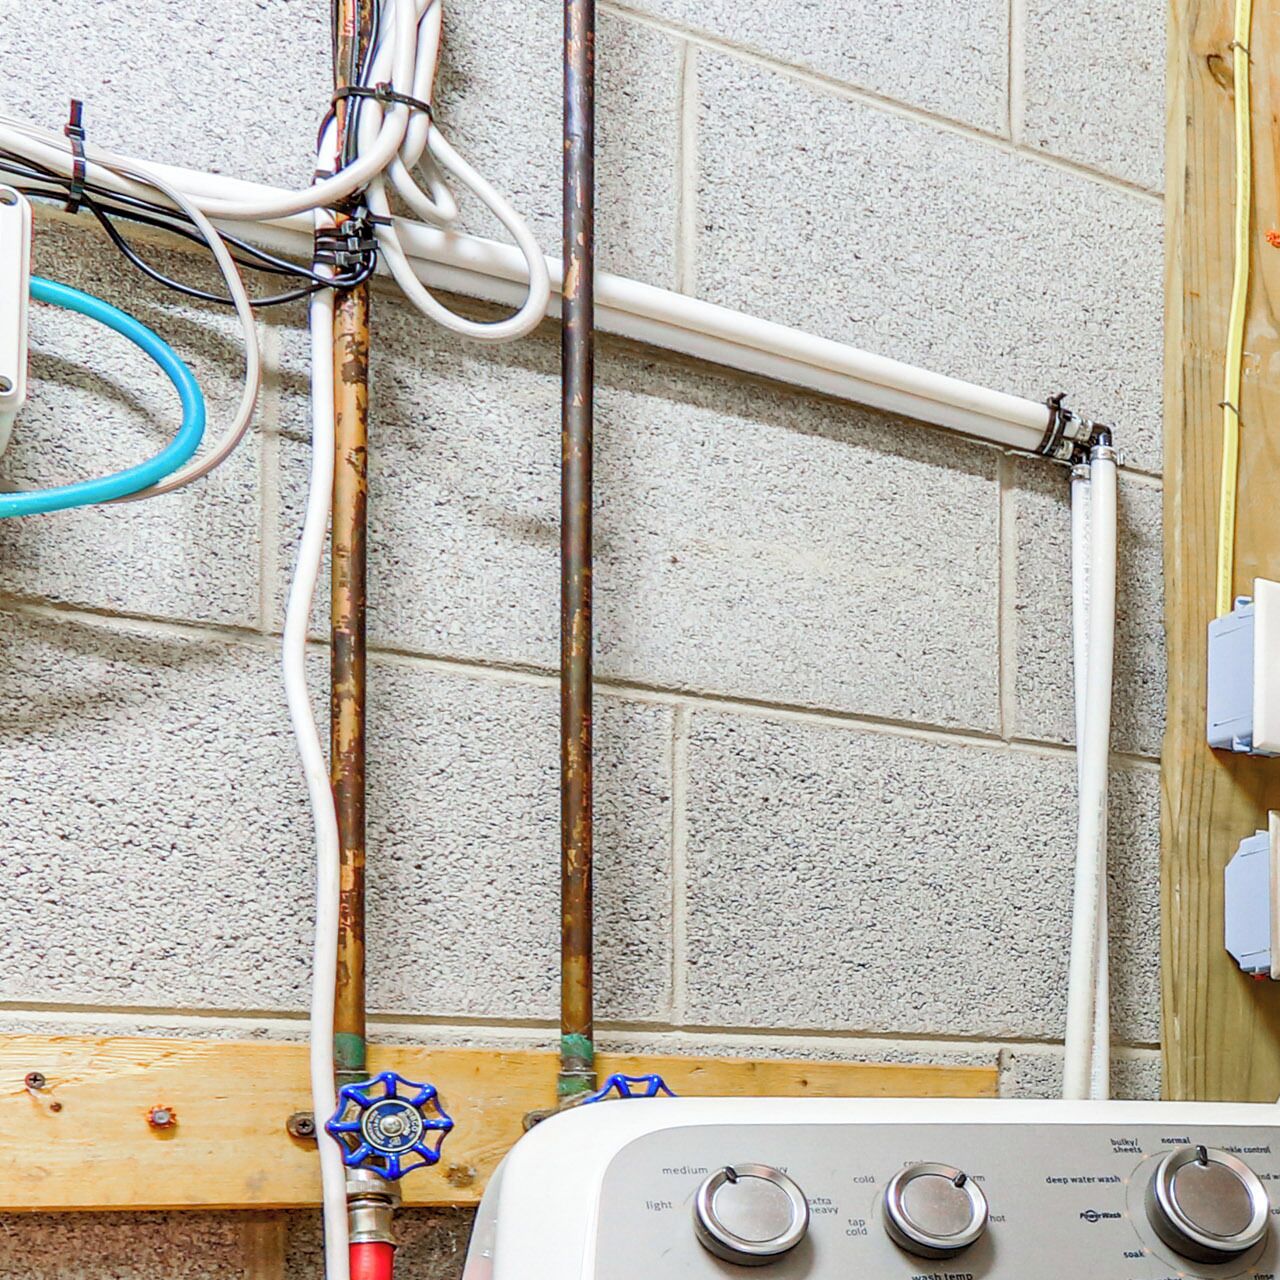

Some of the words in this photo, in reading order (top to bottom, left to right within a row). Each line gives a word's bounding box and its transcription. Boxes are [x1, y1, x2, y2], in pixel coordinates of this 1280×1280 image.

[1243, 1145, 1272, 1154] control
[662, 1166, 709, 1176] medium
[853, 1175, 875, 1184] cold
[1045, 1176, 1069, 1184] deep
[1097, 1175, 1121, 1183] wash
[645, 1201, 673, 1211] light
[848, 1218, 866, 1227] tap
[989, 1214, 1006, 1223] hot
[845, 1228, 868, 1237] cold
[1123, 1250, 1145, 1258] soak
[1253, 1273, 1274, 1280] rinse
